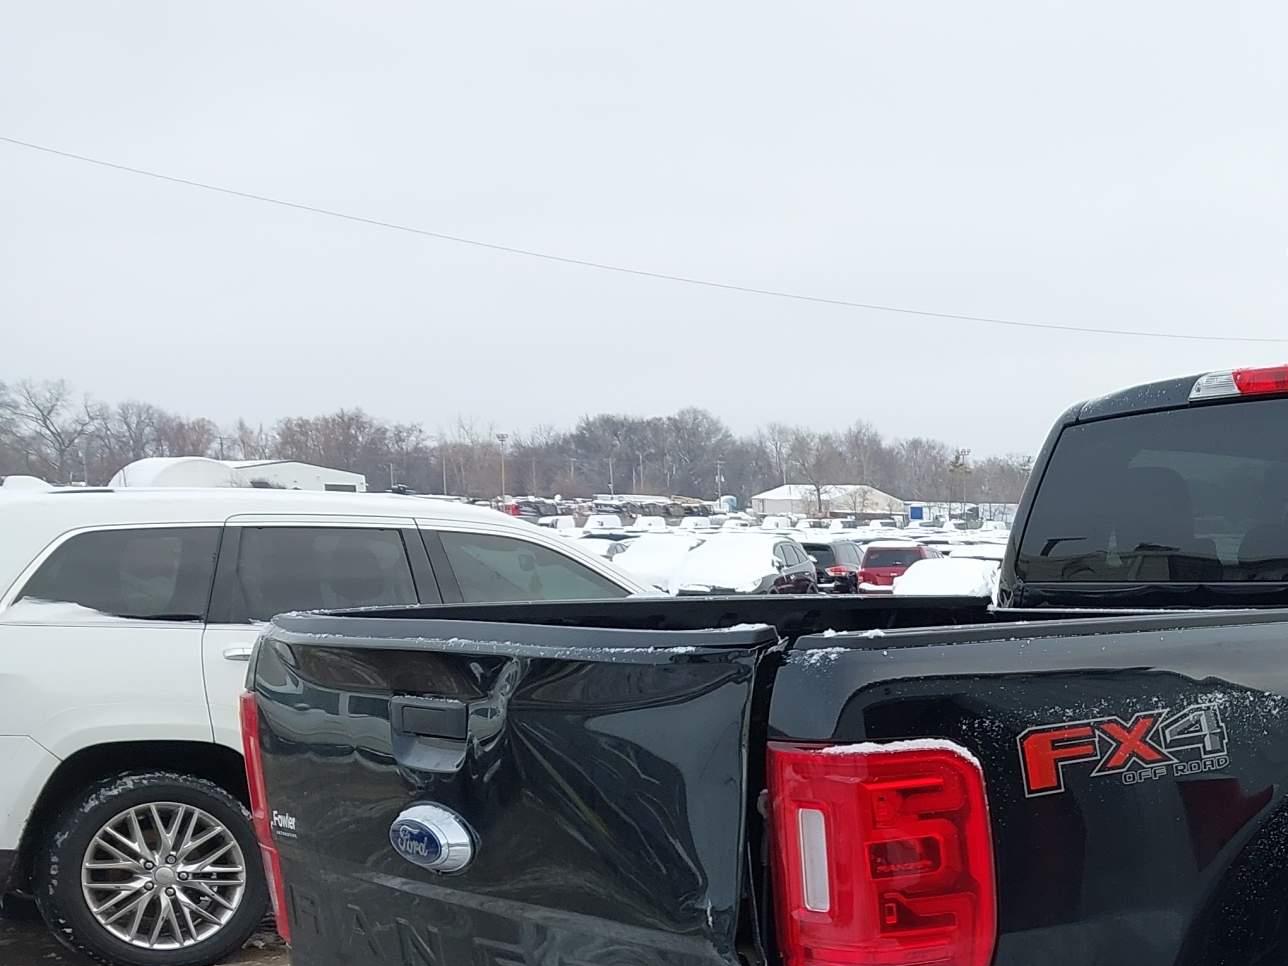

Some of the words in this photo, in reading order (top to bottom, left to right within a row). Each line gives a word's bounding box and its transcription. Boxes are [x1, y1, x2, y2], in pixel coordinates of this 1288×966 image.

[1017, 702, 1229, 798] FX4
[1122, 767, 1169, 785] OFF
[1174, 756, 1230, 776] ROAD
[272, 810, 296, 831] Fowler
[397, 824, 431, 857] Ford
